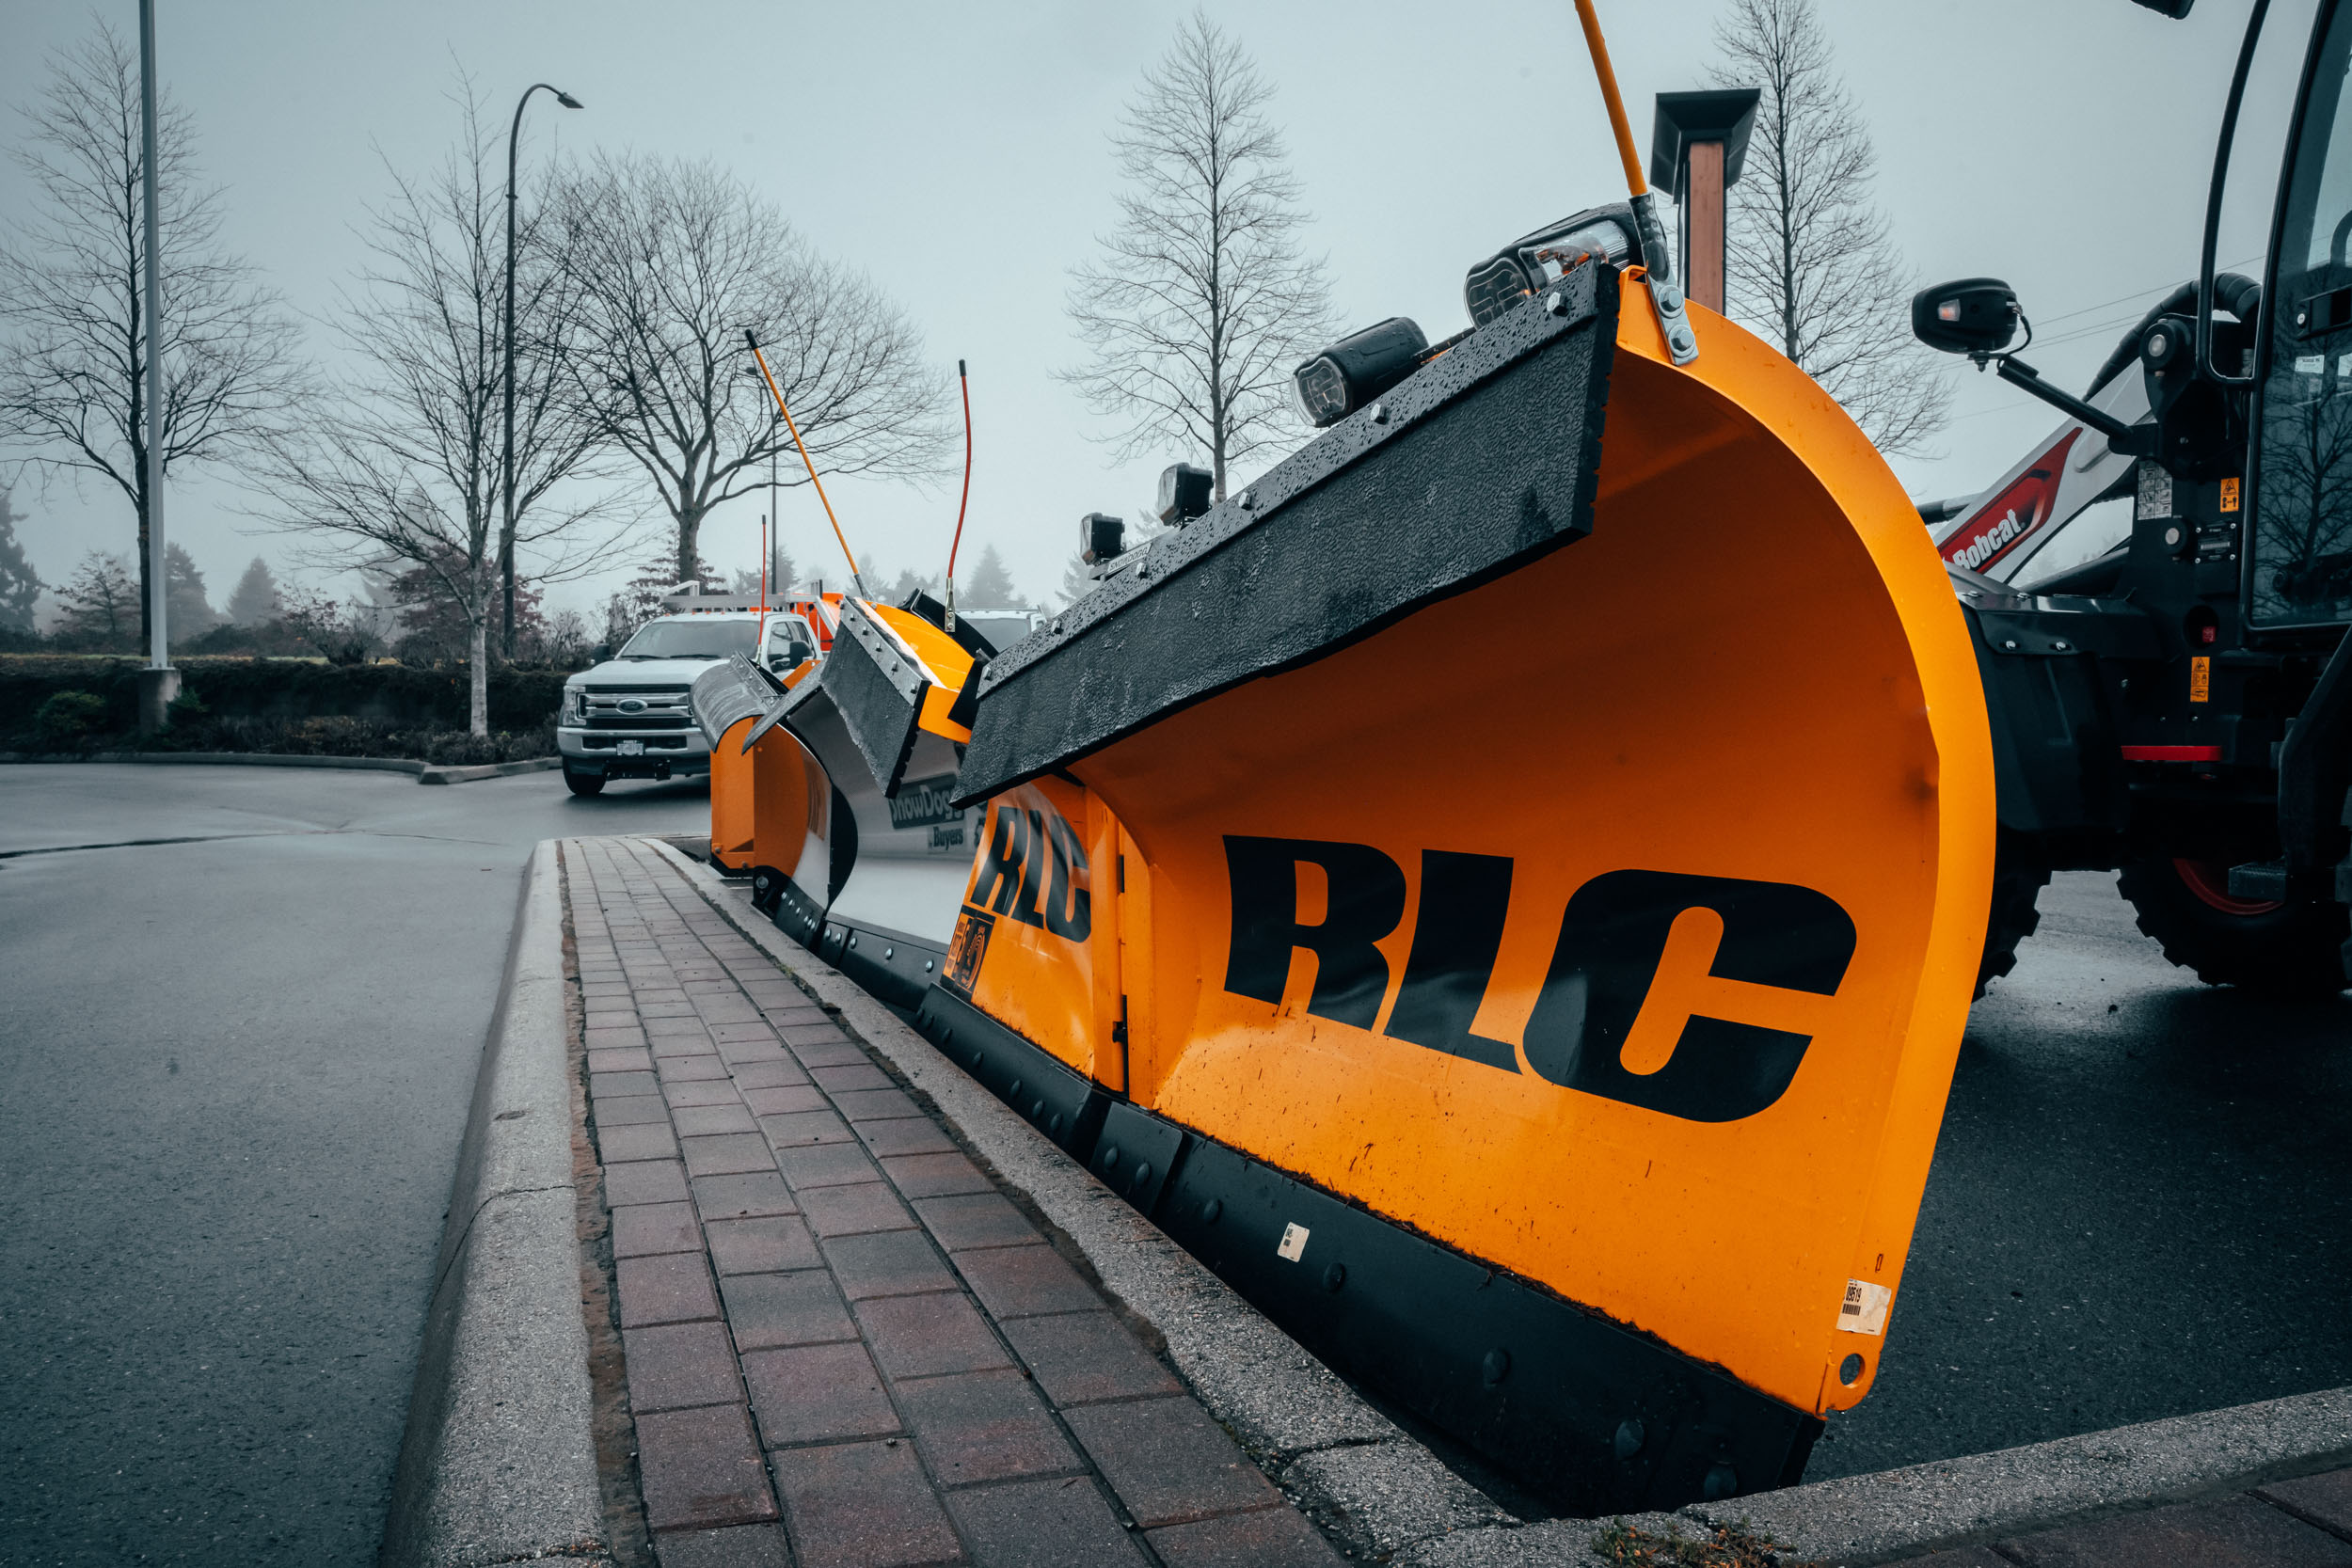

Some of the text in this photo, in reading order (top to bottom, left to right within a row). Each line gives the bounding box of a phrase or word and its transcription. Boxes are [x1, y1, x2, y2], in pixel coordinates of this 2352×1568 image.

[1952, 509, 2021, 569] Bobcat
[933, 827, 962, 850] Buyers
[970, 806, 1091, 942] RLC
[1223, 834, 1857, 1122] RLC
